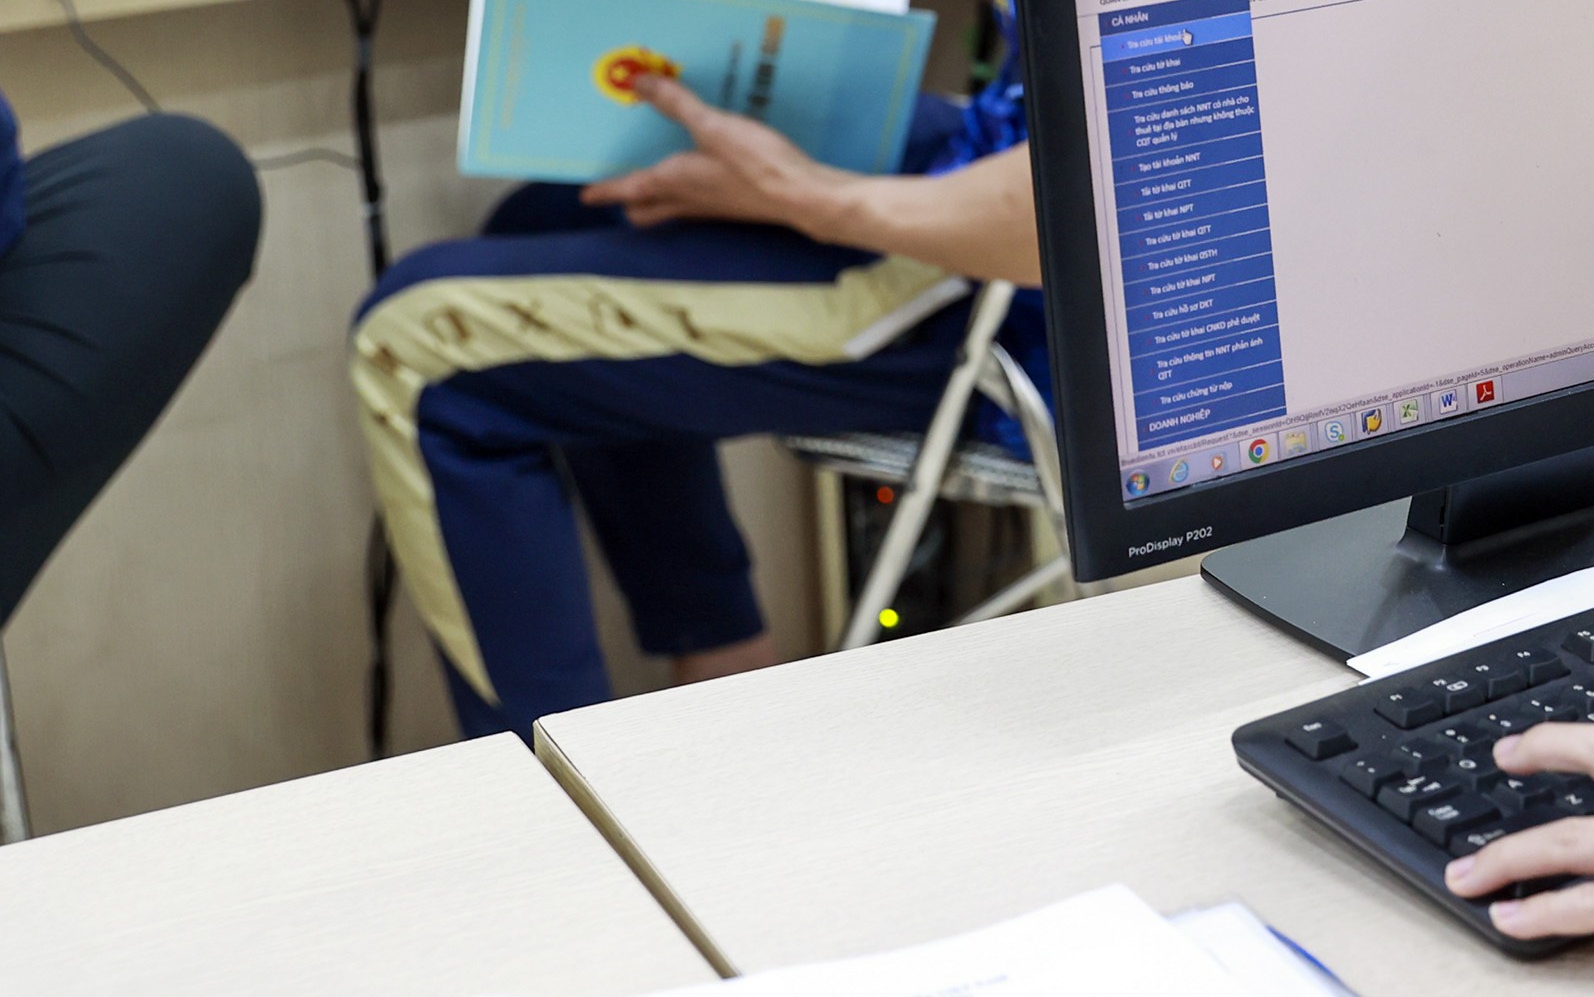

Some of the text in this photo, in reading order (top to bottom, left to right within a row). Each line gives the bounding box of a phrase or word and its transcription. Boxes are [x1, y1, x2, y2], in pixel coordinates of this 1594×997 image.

[1110, 10, 1149, 27] CÁ NHÂN
[1148, 406, 1211, 432] DOANH NGHIỆP
[1128, 526, 1213, 558] ProDisplay P202
